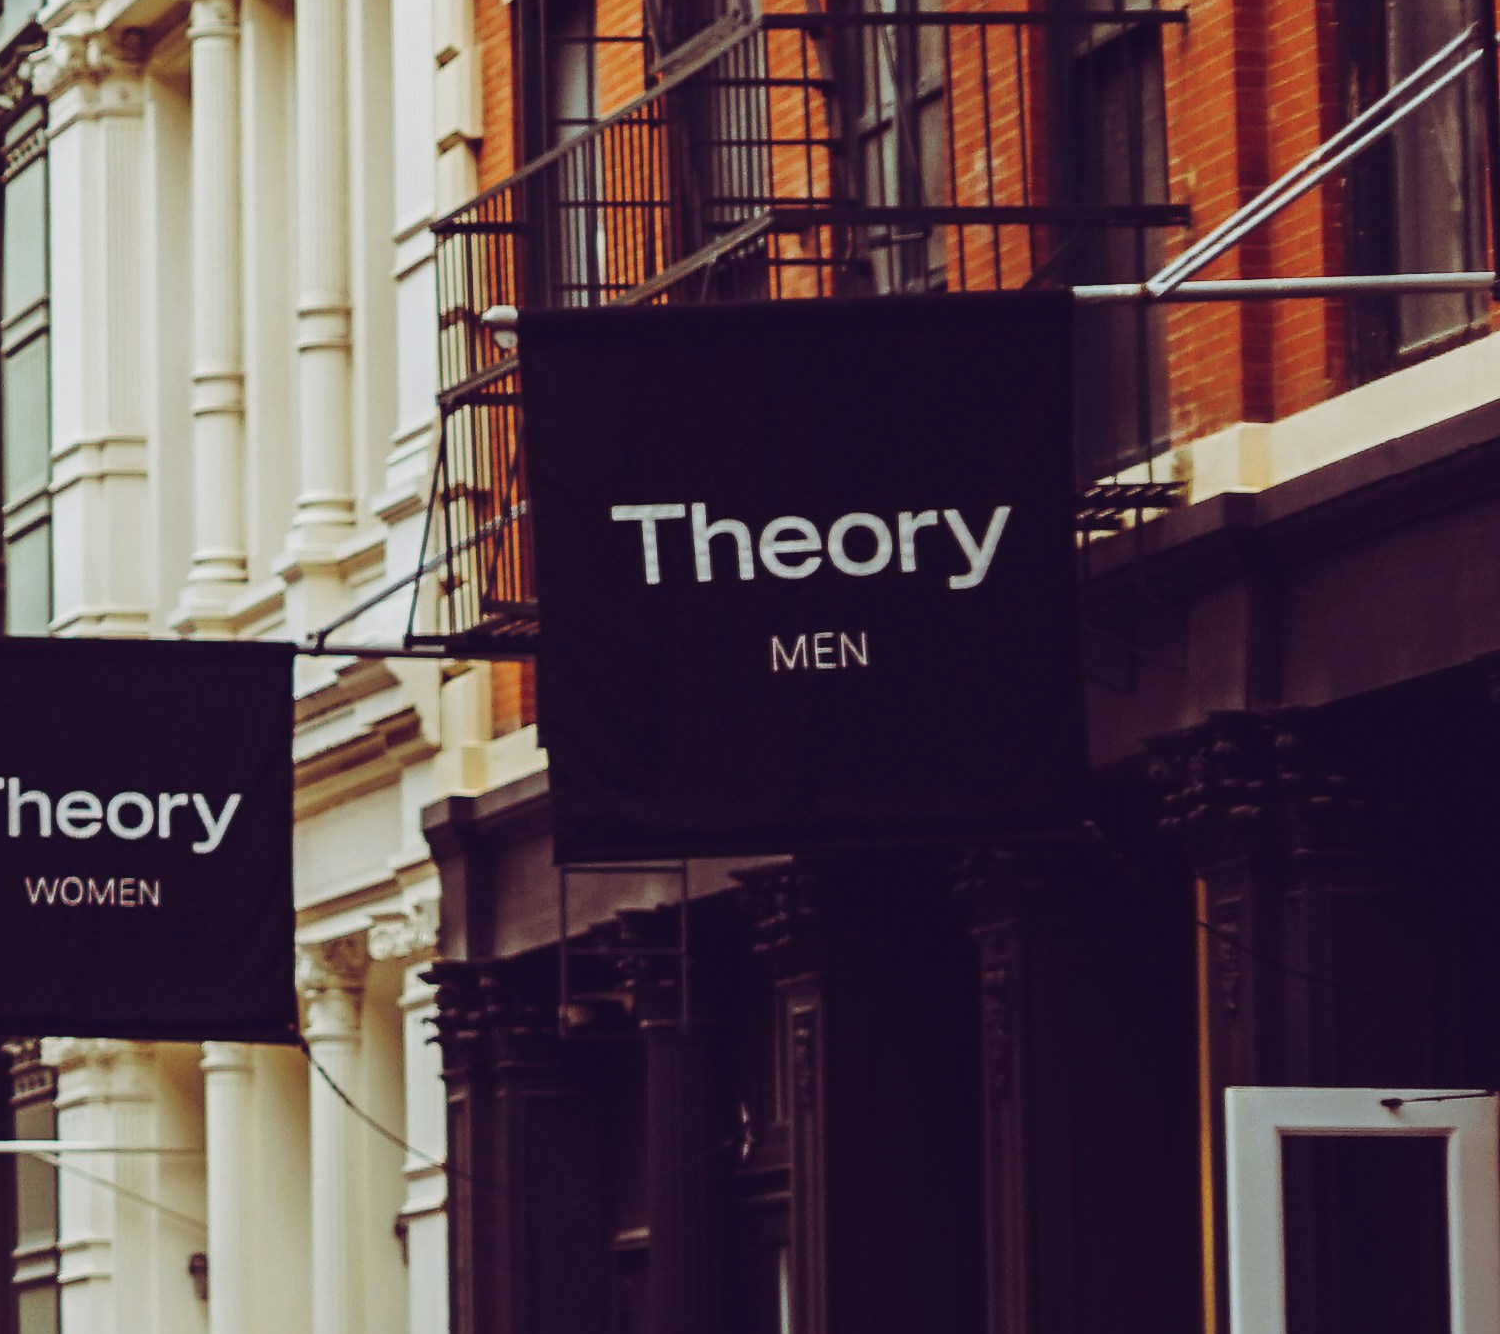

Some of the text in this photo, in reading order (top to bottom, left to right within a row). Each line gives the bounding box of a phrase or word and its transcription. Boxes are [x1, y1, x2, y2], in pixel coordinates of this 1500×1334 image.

[611, 502, 1012, 590] Theory
[771, 631, 869, 672] MEN
[24, 876, 161, 907] WOMEN
